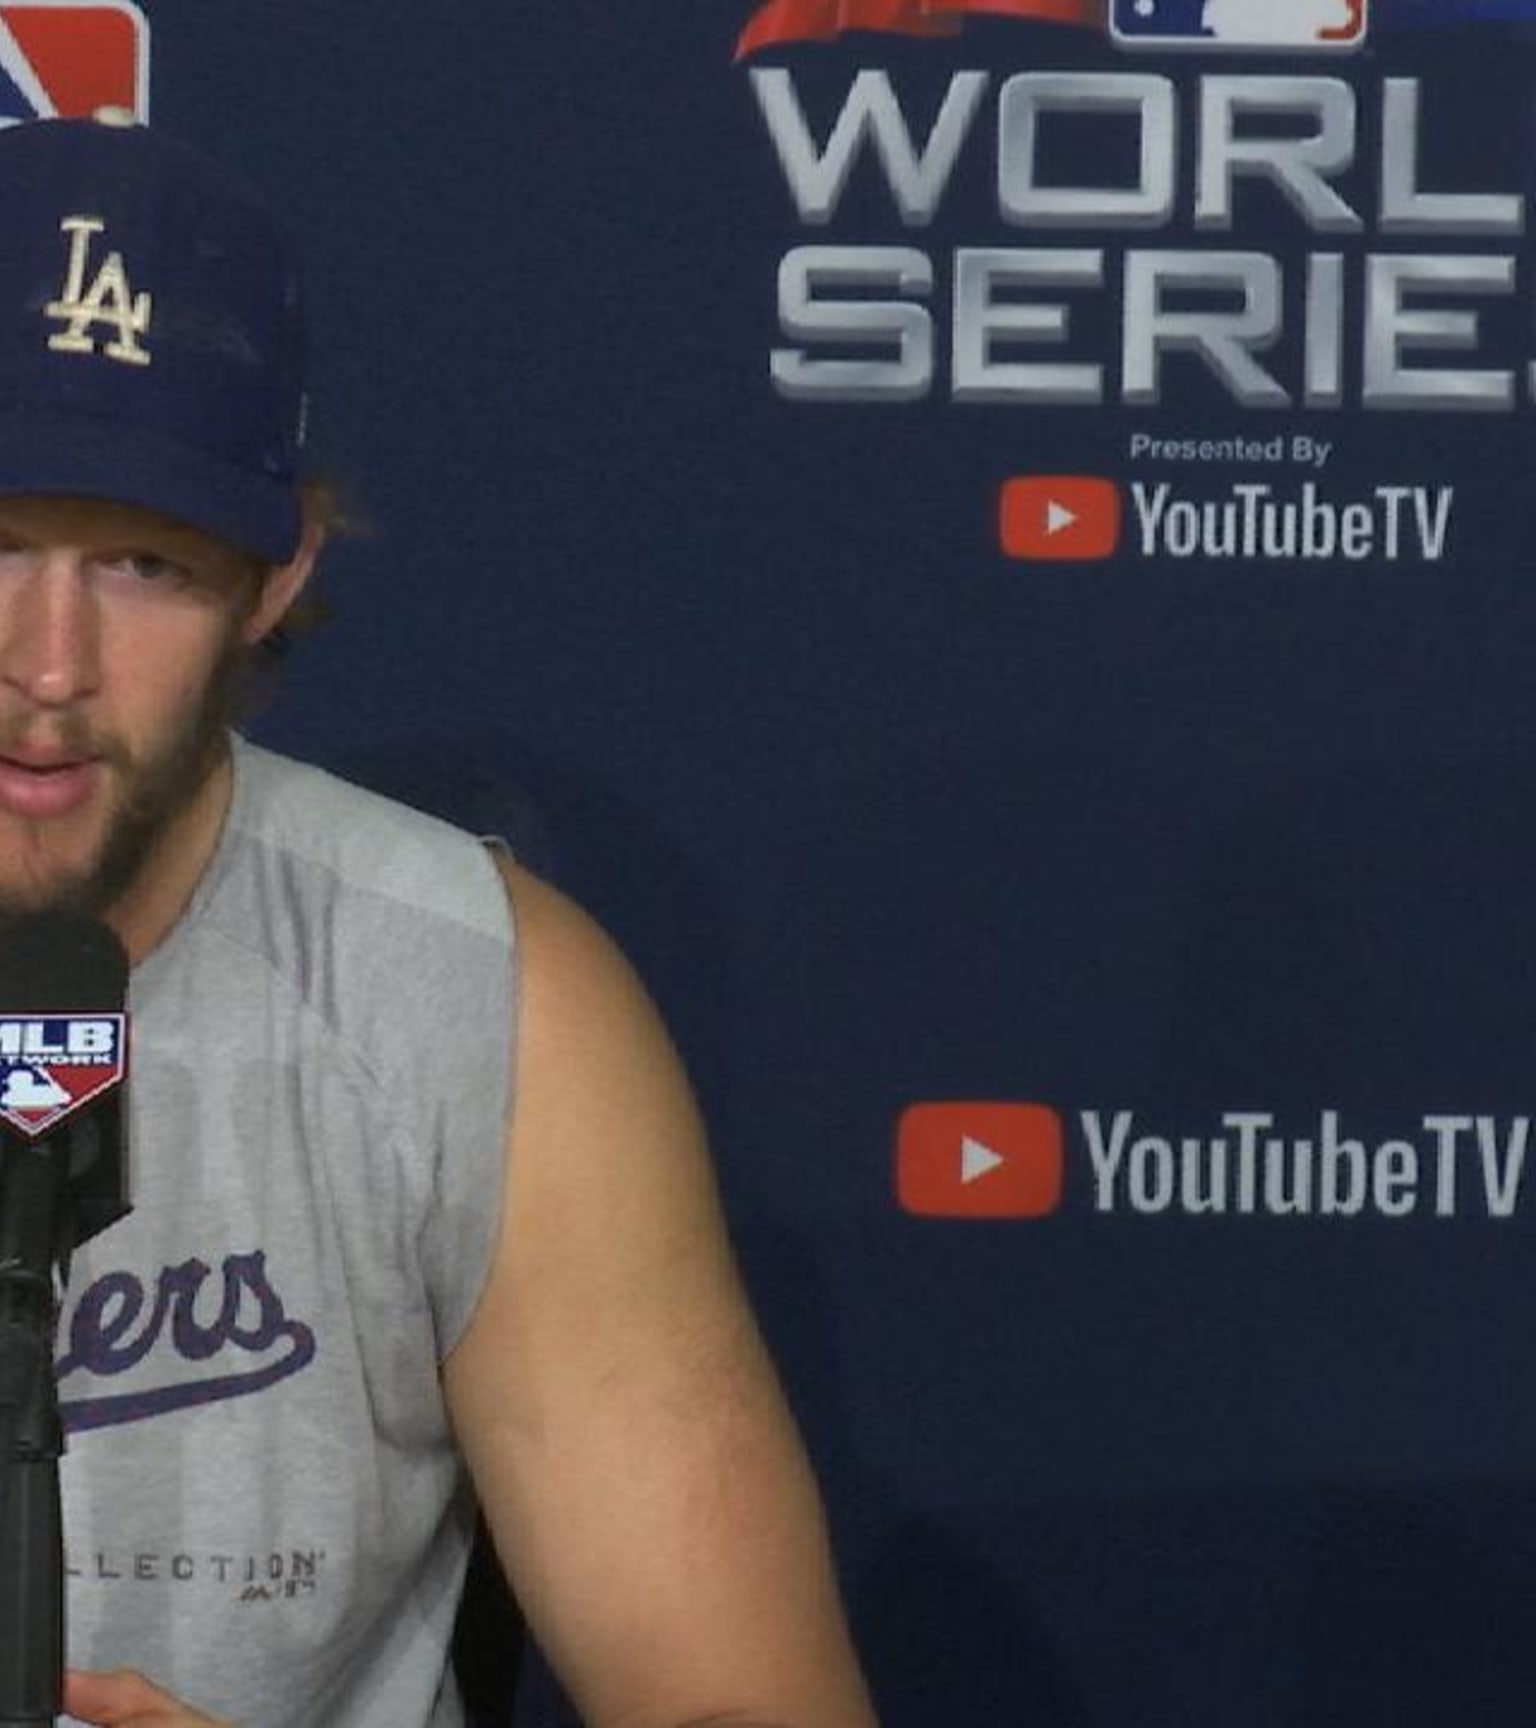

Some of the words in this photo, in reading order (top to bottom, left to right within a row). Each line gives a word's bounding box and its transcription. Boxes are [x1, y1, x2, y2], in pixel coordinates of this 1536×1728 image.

[749, 68, 1526, 235] WORL
[45, 216, 151, 365] LA
[769, 245, 1536, 411] SERIE
[1130, 433, 1284, 462] Presented
[1291, 435, 1332, 468] By
[64, 1550, 317, 1583] LECTION
